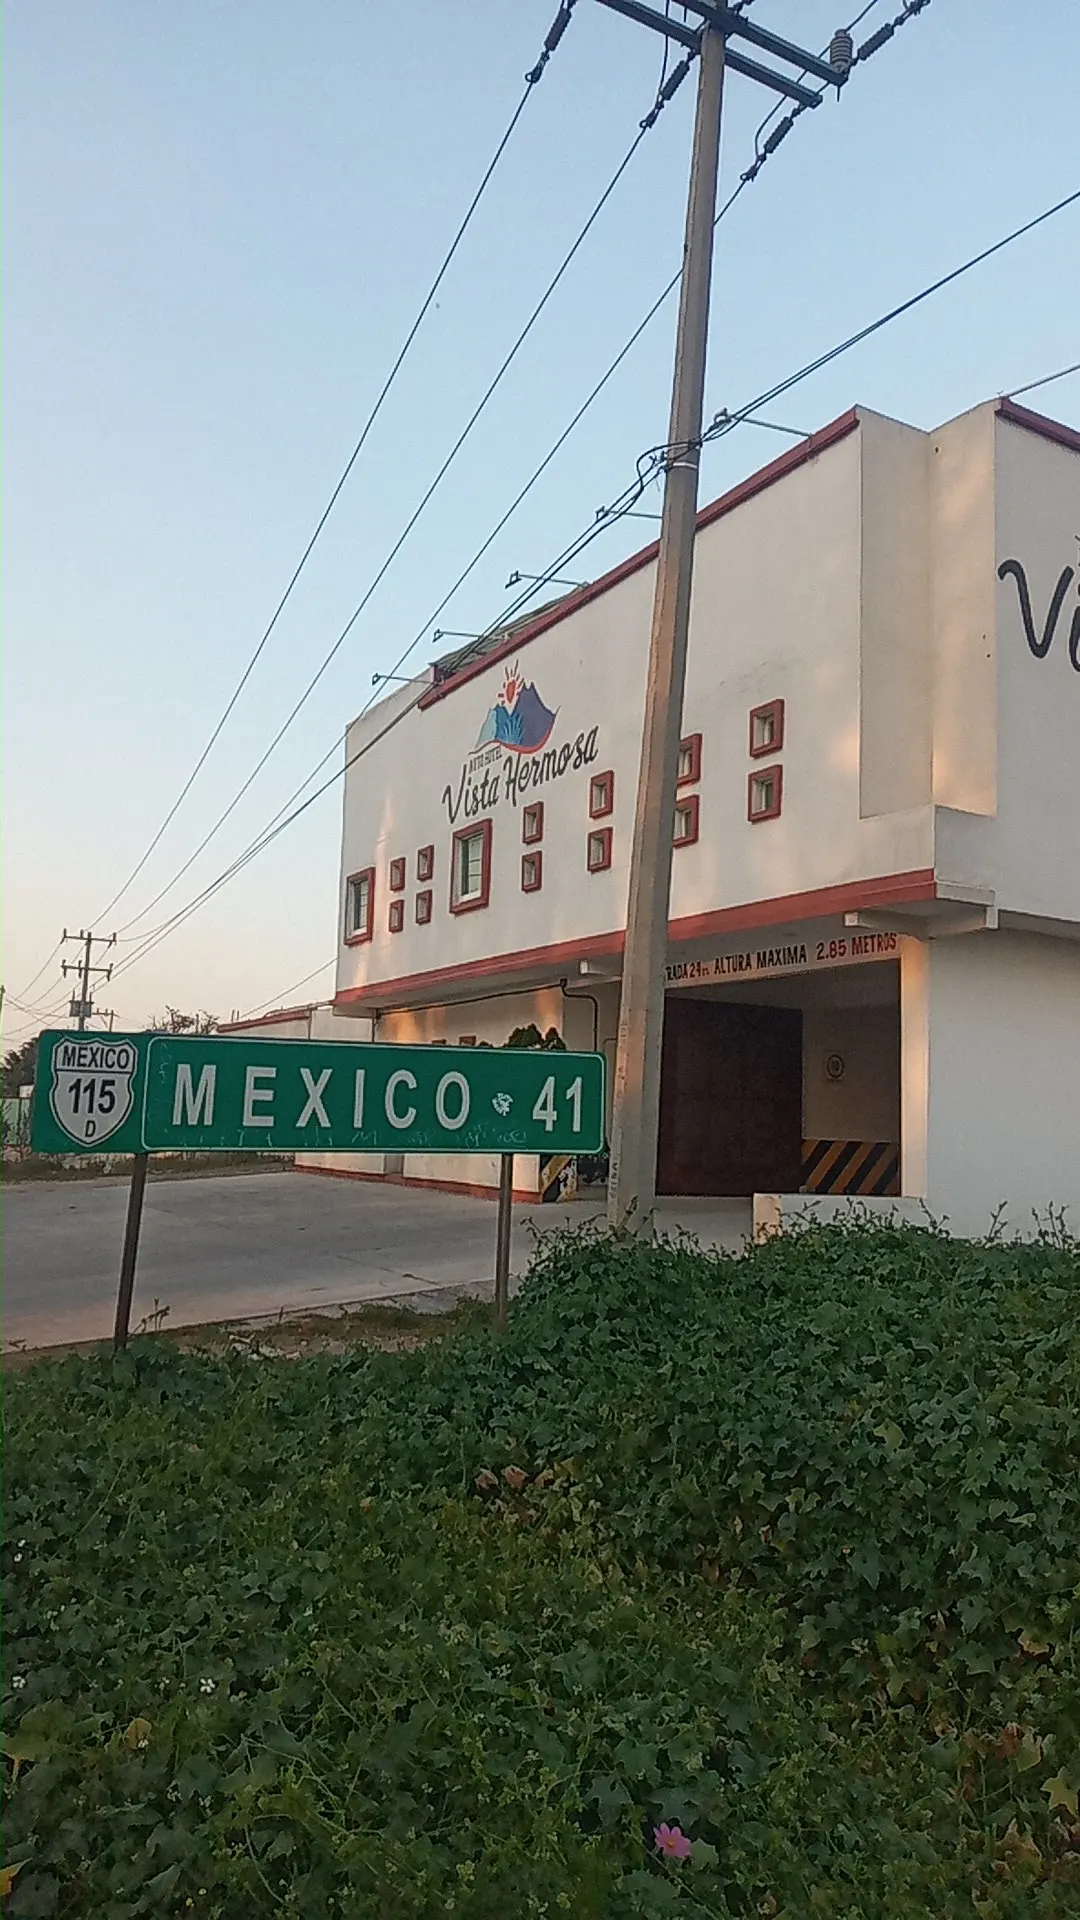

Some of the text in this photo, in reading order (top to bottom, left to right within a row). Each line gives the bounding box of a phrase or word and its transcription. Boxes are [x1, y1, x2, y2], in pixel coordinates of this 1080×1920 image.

[441, 725, 600, 824] Vista Hermosa
[713, 952, 752, 975] ALTURA
[756, 943, 807, 970] MAXIMA
[816, 938, 848, 961] 2.85
[851, 931, 898, 956] METROS
[61, 1045, 130, 1070] MEXICO
[68, 1078, 116, 1114] 115
[172, 1063, 583, 1133] MEXICO 41
[84, 1119, 96, 1138] D
